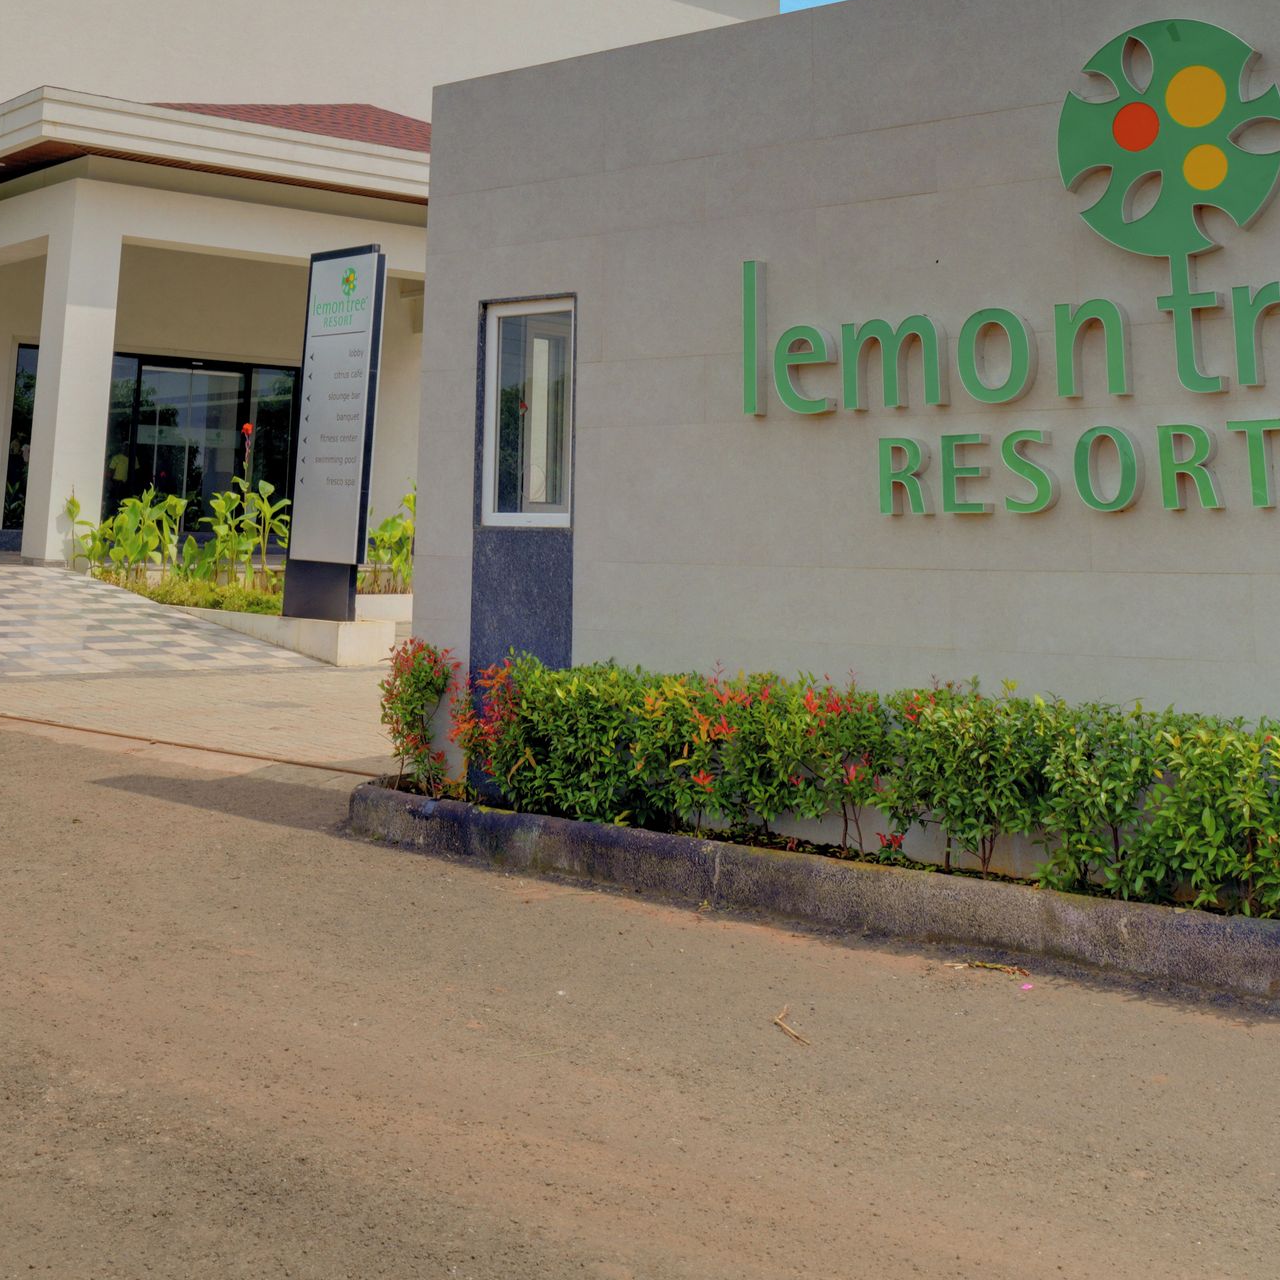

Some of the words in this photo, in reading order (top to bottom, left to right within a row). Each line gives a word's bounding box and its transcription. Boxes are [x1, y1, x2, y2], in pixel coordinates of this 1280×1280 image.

[312, 294, 344, 316] lemon
[323, 315, 353, 328] RESORT
[741, 260, 1134, 416] lemon
[348, 348, 364, 359] lobby
[336, 412, 360, 423] banquet
[345, 478, 355, 488] spa
